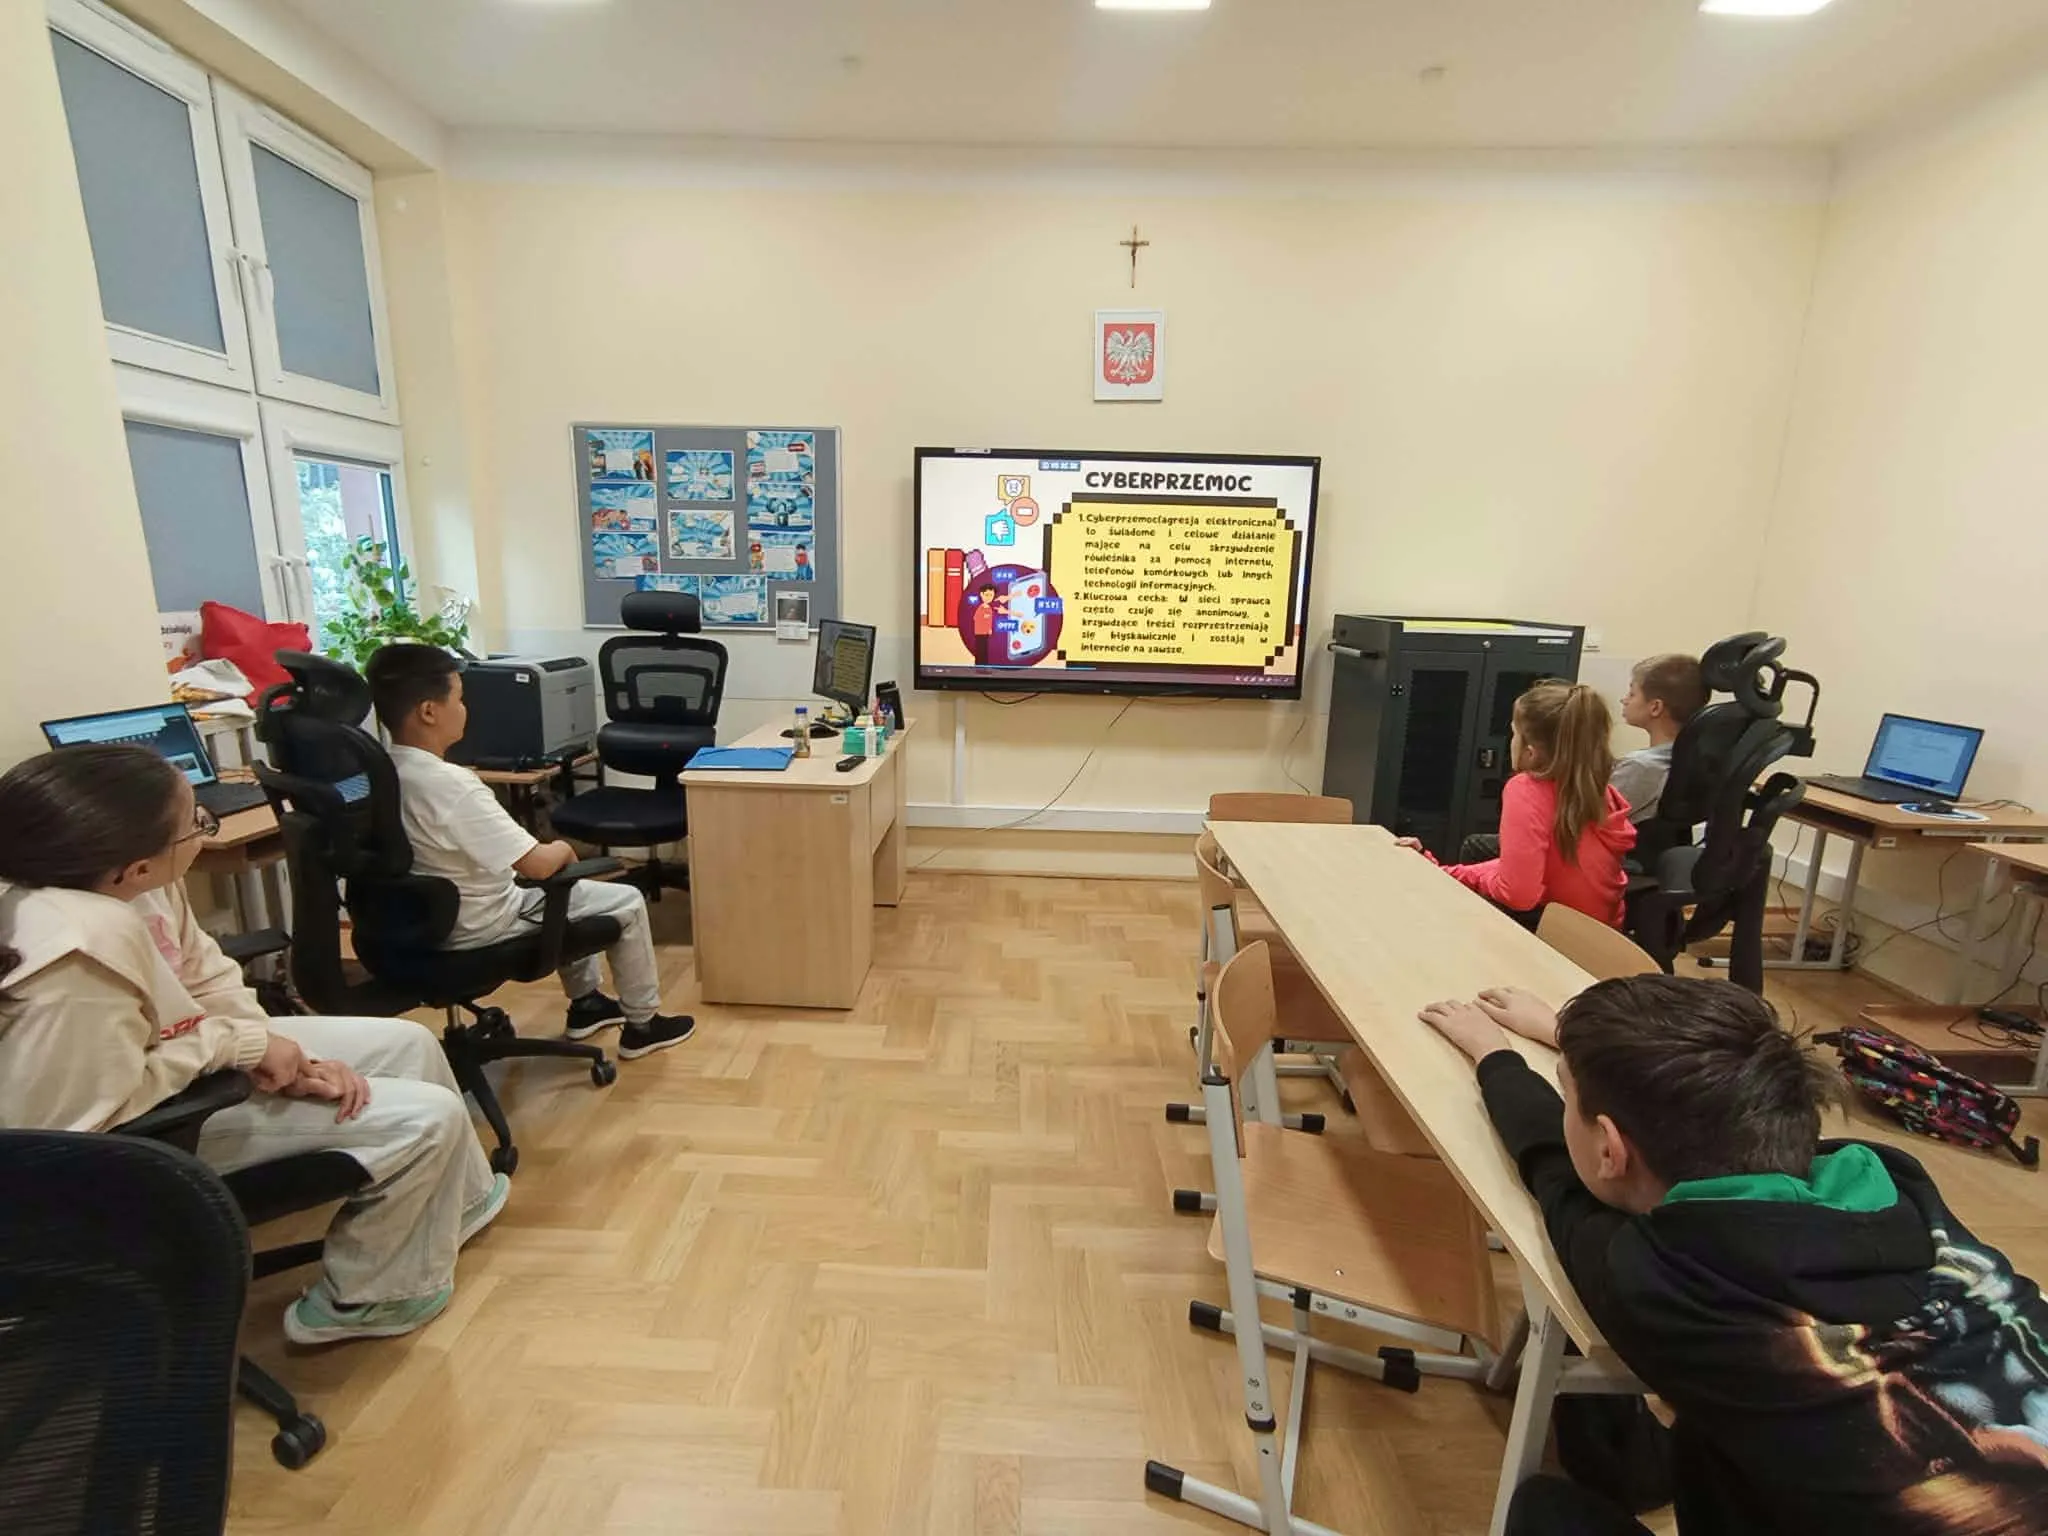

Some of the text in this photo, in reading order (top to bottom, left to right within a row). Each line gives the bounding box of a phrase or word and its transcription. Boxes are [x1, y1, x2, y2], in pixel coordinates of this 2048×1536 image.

[1085, 471, 1252, 492] CYBERPRZEMOC
[1205, 517, 1277, 527] elektroniczna)
[1086, 527, 1096, 535] to
[1184, 530, 1219, 538] celowe
[1231, 530, 1276, 540] działanie
[1085, 540, 1121, 550] mające
[1169, 542, 1191, 551] celu
[1209, 543, 1275, 554] skrzywdzenie
[1174, 556, 1212, 568] pomocą
[1084, 566, 1273, 581] telefonów komórkowych lub innych
[1084, 579, 1137, 590] technologii
[1083, 592, 1128, 602] Kluczowa
[1198, 595, 1220, 604] sieci
[1230, 597, 1271, 606] sprawca
[1082, 605, 1115, 615] często
[1128, 607, 1154, 616] czuje
[1167, 607, 1183, 616] się
[1082, 617, 1269, 633] krzywdzące treści rozprzestrzeniają
[1082, 631, 1096, 640] się
[1111, 631, 1177, 641] błyskawicznie
[1210, 634, 1245, 645] zostają
[1081, 643, 1131, 653] internecie
[1133, 645, 1146, 653] na
